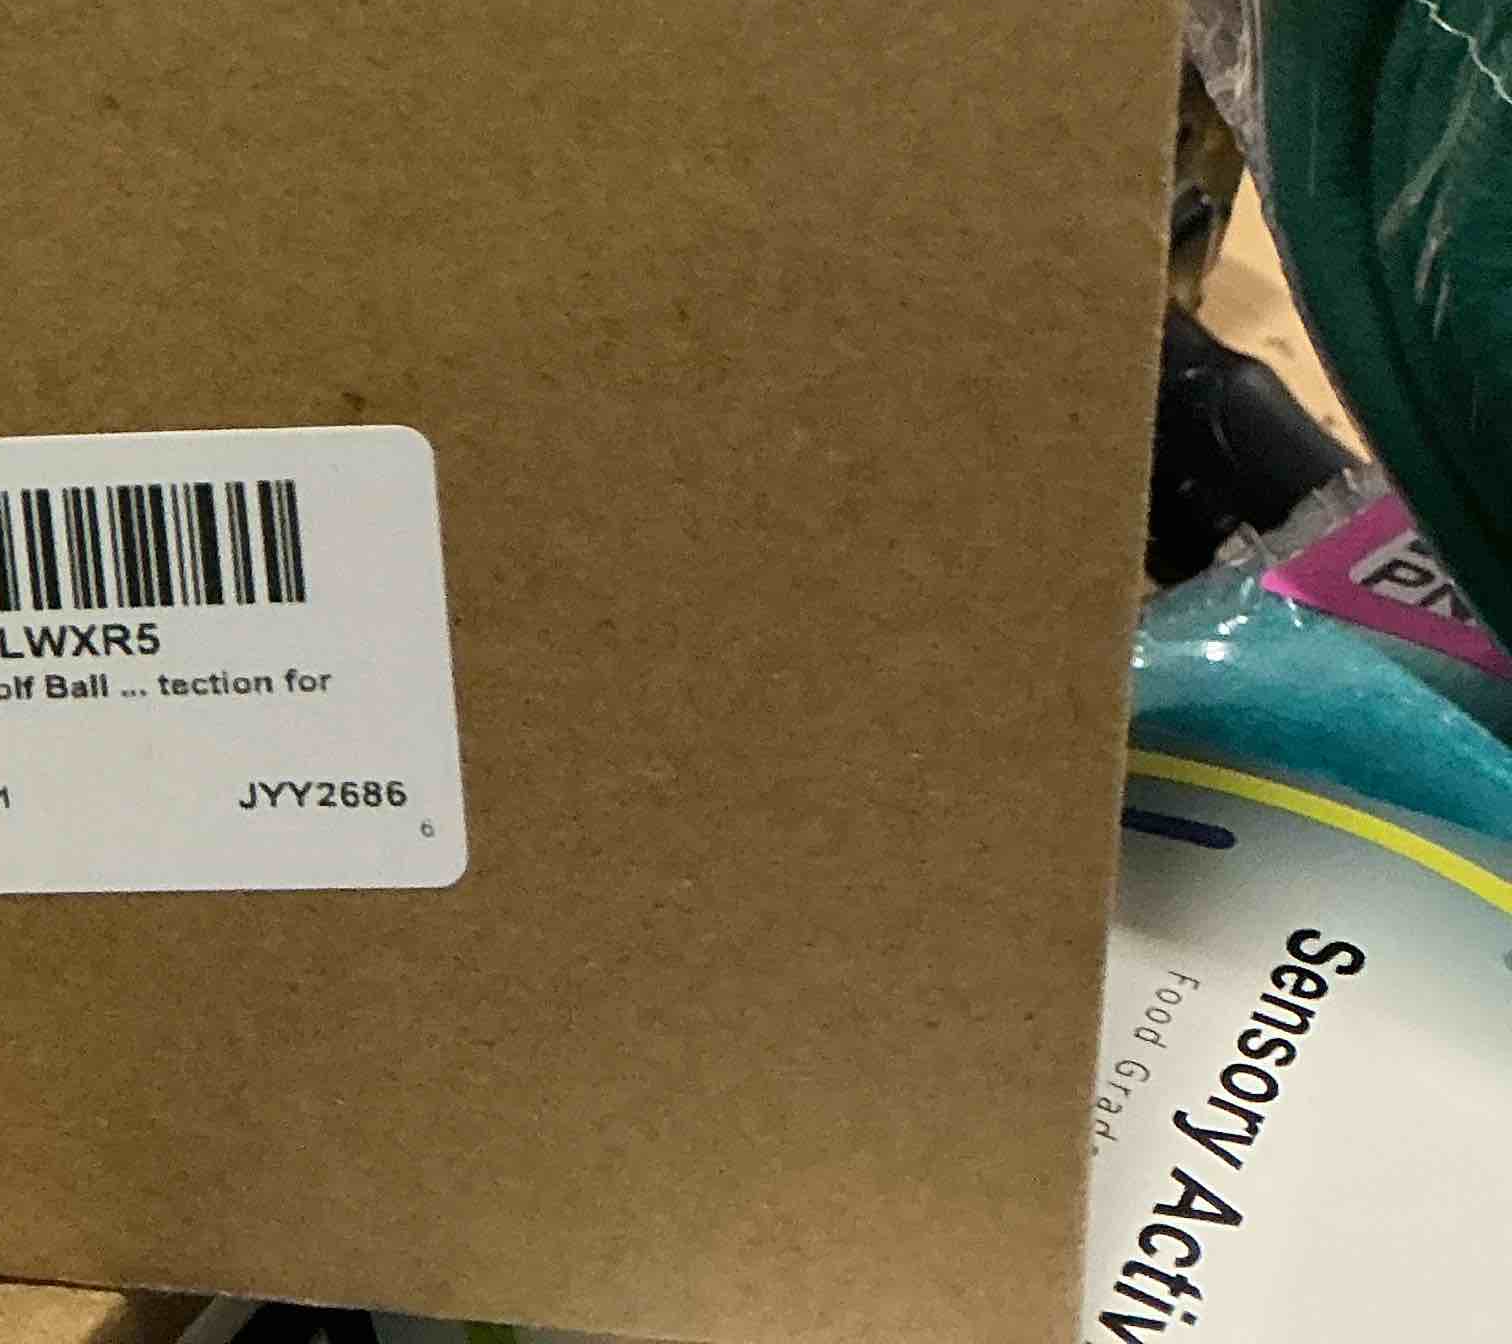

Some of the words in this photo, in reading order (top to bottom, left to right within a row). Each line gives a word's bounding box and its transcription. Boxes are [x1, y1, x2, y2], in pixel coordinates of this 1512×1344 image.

[45, 673, 109, 699] Ball
[159, 671, 273, 696] tection
[285, 669, 332, 692] for
[239, 780, 407, 808] JYY2686
[1133, 970, 1200, 1049] Food
[1171, 927, 1366, 1170] Sensory
[1091, 1059, 1151, 1156] Grad
[1086, 1166, 1244, 1344] Activ
